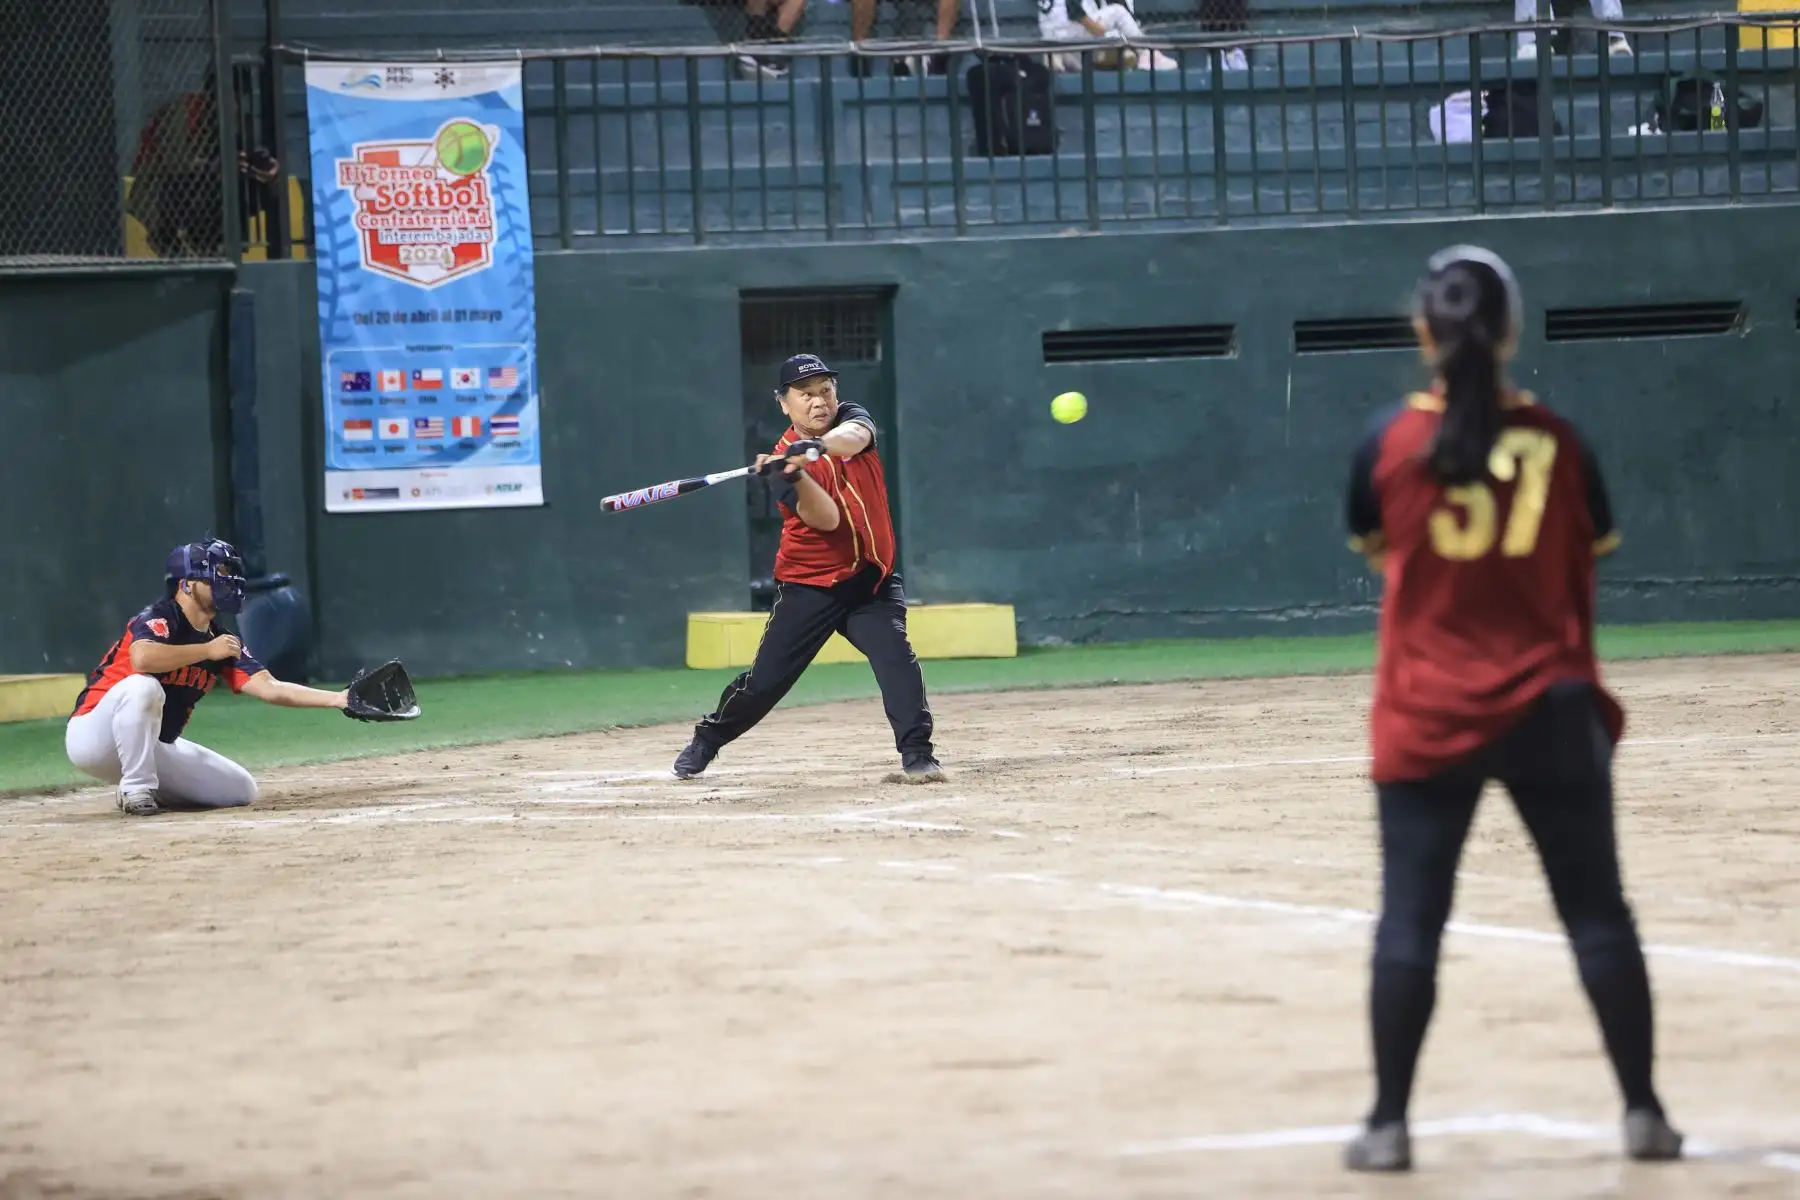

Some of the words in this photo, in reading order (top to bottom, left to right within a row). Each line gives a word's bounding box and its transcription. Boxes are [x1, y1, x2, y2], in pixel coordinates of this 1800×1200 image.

[364, 166, 434, 181] Torneo
[376, 182, 485, 207] Softbol
[359, 211, 487, 227] Confraternidad
[380, 230, 490, 243] Interembajadas
[401, 248, 451, 264] 2024
[353, 311, 374, 325] Del
[376, 311, 391, 325] 20
[393, 310, 408, 324] de
[411, 309, 438, 324] abril
[441, 310, 452, 323] al
[469, 309, 503, 323] mayo
[608, 480, 681, 512] RIVAL
